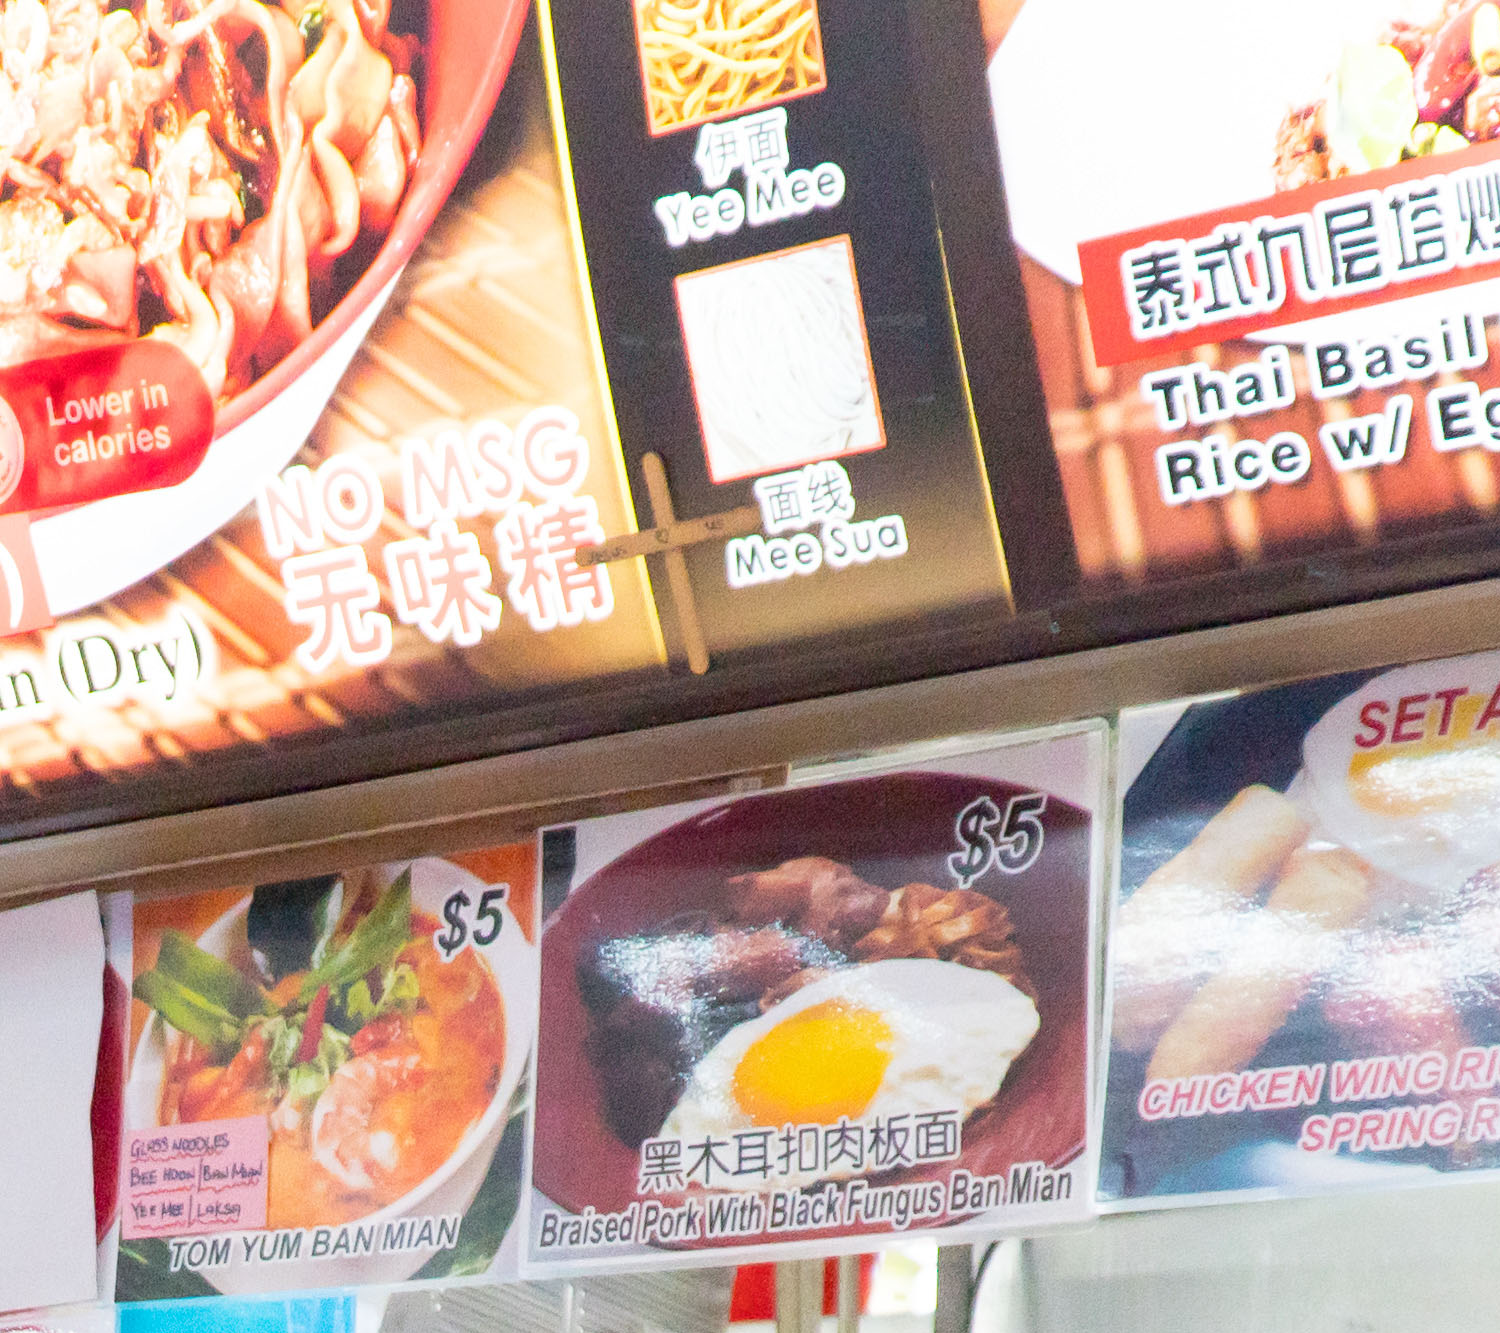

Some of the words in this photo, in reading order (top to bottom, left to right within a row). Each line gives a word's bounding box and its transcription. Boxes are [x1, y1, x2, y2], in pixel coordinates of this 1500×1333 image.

[665, 194, 739, 233] Yee
[751, 173, 839, 217] Mee
[46, 386, 134, 428] Lower
[140, 379, 169, 410] in
[1148, 354, 1292, 429] Thai
[1316, 311, 1485, 393] Basil
[53, 423, 173, 468] calories
[1161, 436, 1304, 500] Rice
[1331, 398, 1413, 466] w/
[264, 465, 377, 547] NO
[407, 416, 585, 519] MSG
[289, 505, 608, 661] 无味精
[734, 536, 816, 575] Mee
[823, 523, 900, 560] Sua
[56, 613, 205, 704] (Dry)
[1353, 690, 1469, 749] SET
[949, 794, 1047, 886] $5
[437, 888, 505, 959] $5
[1139, 1063, 1325, 1120] CHICKEN
[1330, 1052, 1446, 1100] WING
[640, 1112, 961, 1190] 黑木耳扣肉板面
[1298, 1105, 1462, 1152] SPRING
[197, 1202, 241, 1217] LAKSA
[539, 1210, 634, 1248] Braised
[643, 1202, 701, 1239] Pork
[706, 1197, 766, 1234] With
[771, 1190, 841, 1228] Black
[846, 1179, 943, 1227] Fungus
[951, 1171, 1002, 1211] Ban
[1008, 1167, 1072, 1203] Mian
[170, 1237, 229, 1271] TOM
[242, 1230, 302, 1263] YUM
[312, 1223, 375, 1258] BAN
[383, 1216, 461, 1250] MIAN
